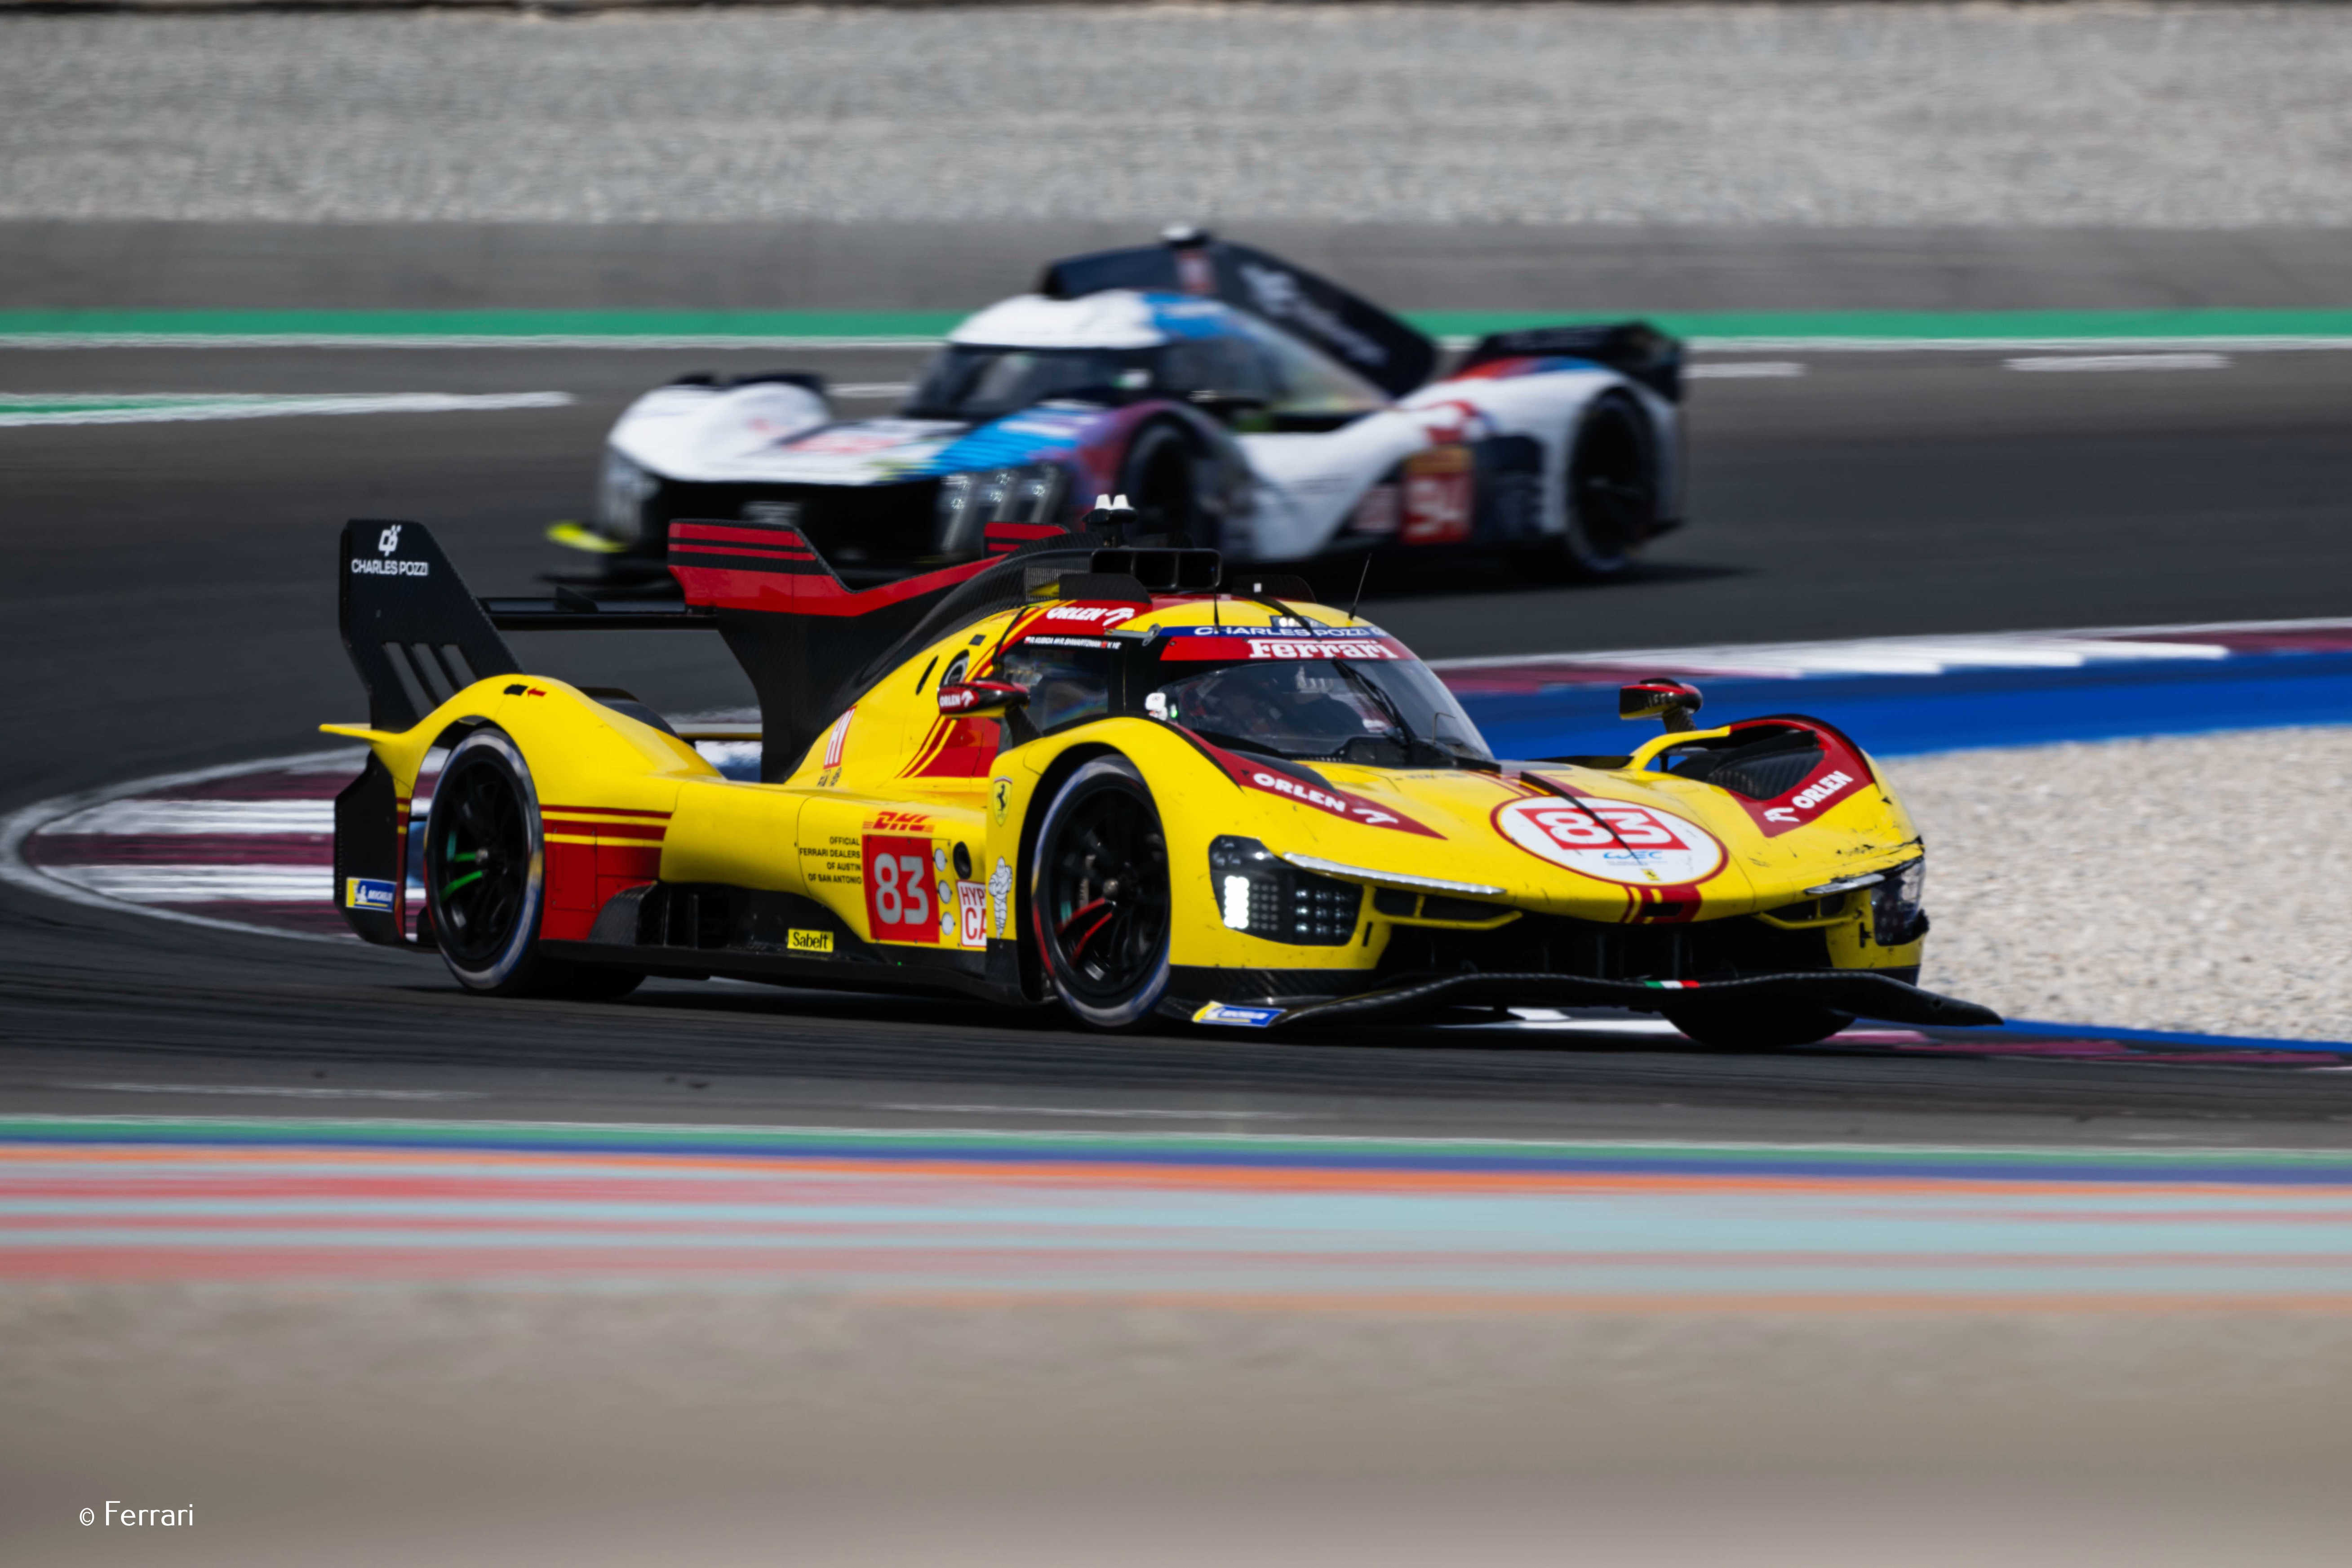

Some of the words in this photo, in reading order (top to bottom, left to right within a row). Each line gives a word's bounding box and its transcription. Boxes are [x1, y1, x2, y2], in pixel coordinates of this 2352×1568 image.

[352, 560, 398, 575] CHARLES
[399, 562, 428, 576] POZZI
[1047, 607, 1108, 621] ORLEN
[1194, 626, 1311, 636] CHARLES
[1247, 640, 1398, 658] Ferrari
[940, 694, 960, 707] ORLEN
[1253, 773, 1346, 812] ORLEN
[1792, 770, 1854, 808] ORLEN
[873, 811, 930, 831] DHL
[1536, 812, 1672, 844] 83
[830, 836, 860, 846] OFFICIAL
[799, 848, 828, 856] FERRARI
[830, 849, 860, 858] DEALERS
[1603, 850, 1662, 859] WEC
[837, 863, 861, 871] AUSTIN
[833, 875, 862, 884] ANTONIO
[874, 853, 929, 924] 83
[793, 932, 828, 949] Sabelt
